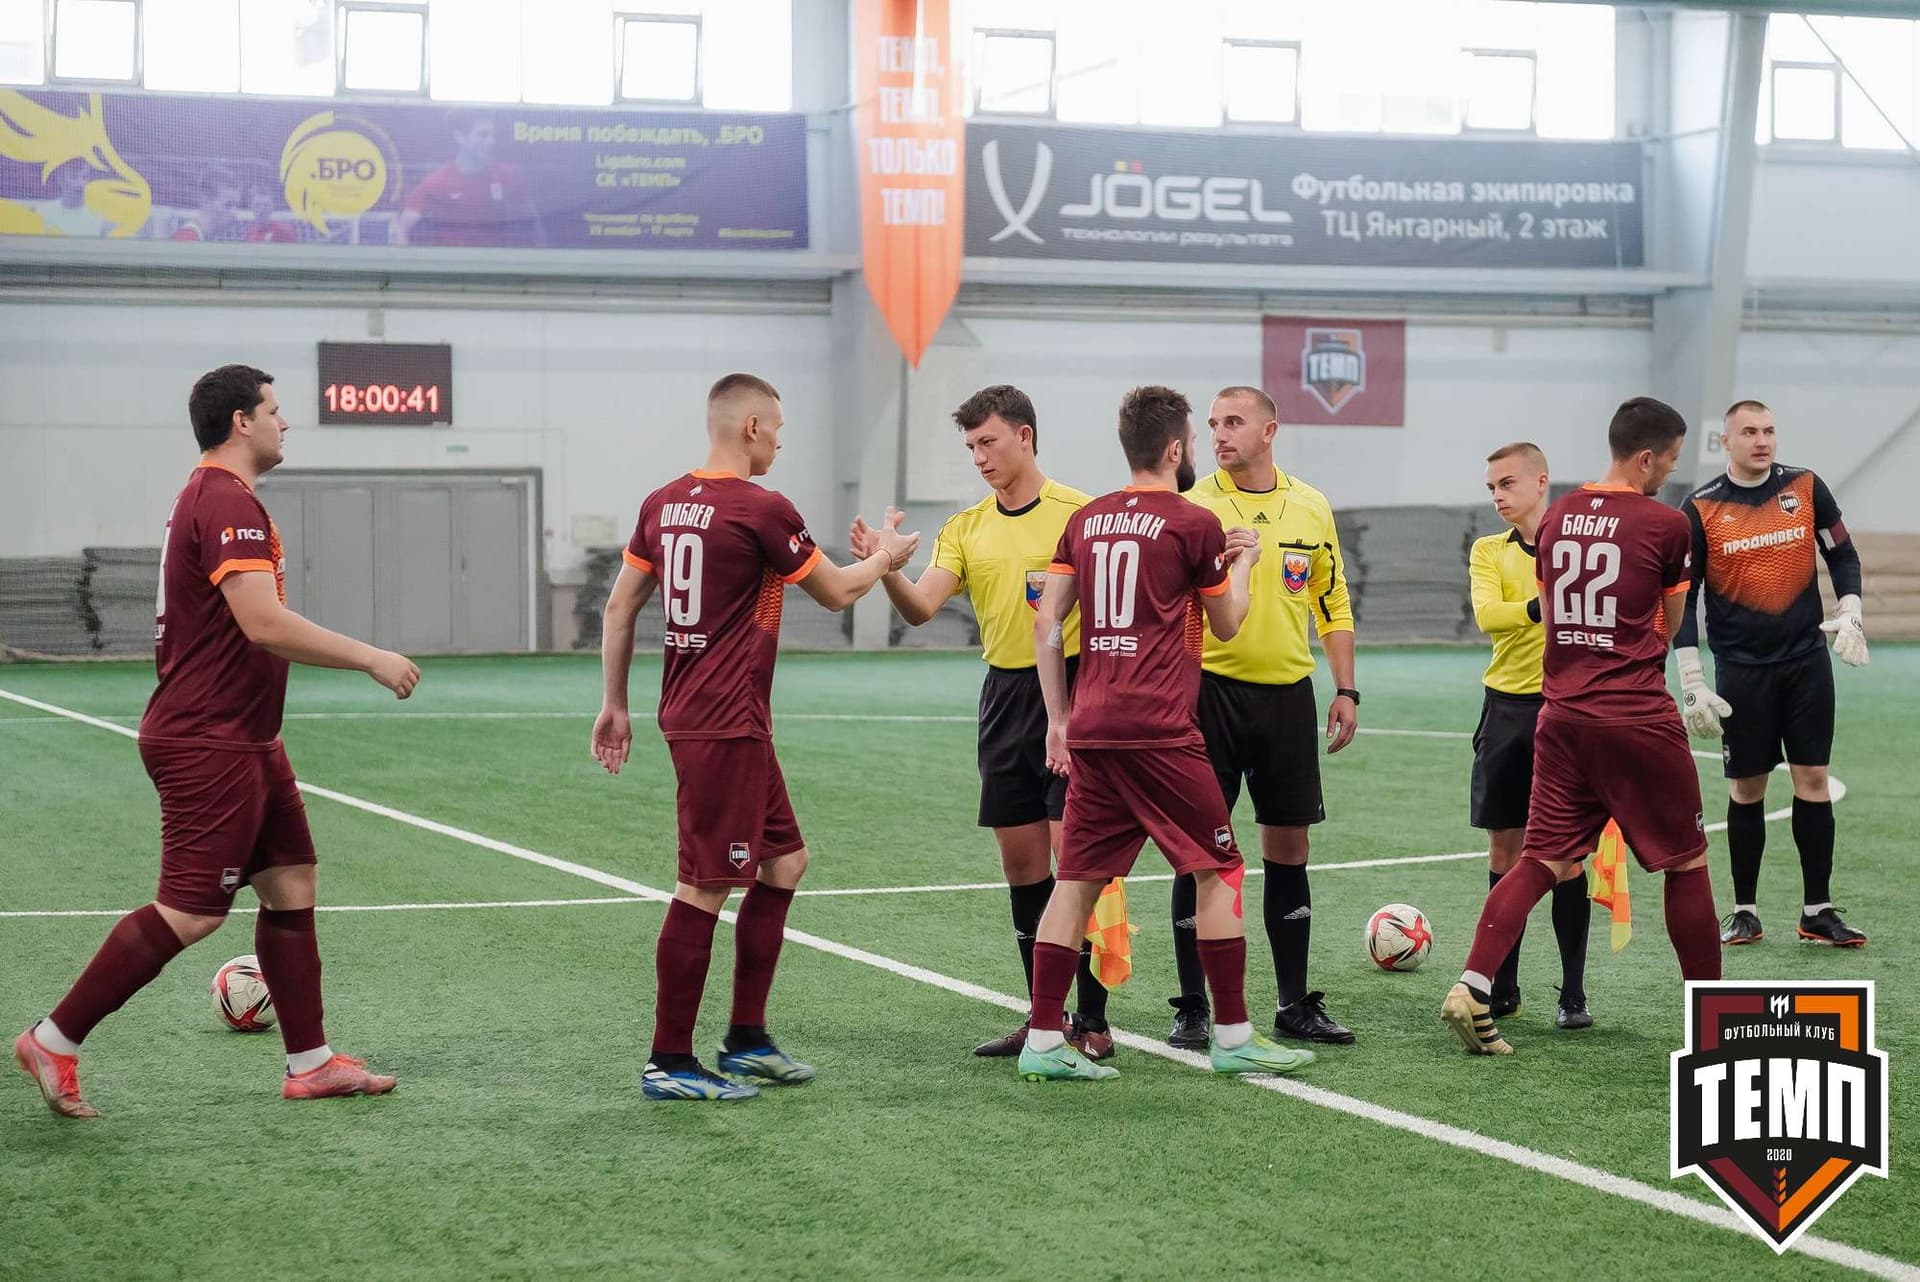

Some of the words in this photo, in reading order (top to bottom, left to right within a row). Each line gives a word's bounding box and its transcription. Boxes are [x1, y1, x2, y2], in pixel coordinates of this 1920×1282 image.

[513, 121, 582, 144] Время
[588, 123, 709, 147] побеждать,
[714, 125, 764, 145] .БРО
[310, 157, 377, 182] .БРО
[868, 137, 957, 176] ТОЛЬКО
[1292, 172, 1465, 204] Футбольная
[1472, 180, 1635, 208] экипировка
[1321, 209, 1362, 241] ТЦ
[1366, 210, 1511, 243] Янтарный,
[1517, 211, 1535, 239] 2
[1541, 216, 1609, 239] этаж
[324, 383, 441, 413] 18:00:41
[660, 502, 716, 530] ШИБАЕВ
[1083, 511, 1167, 541] АПАЛЬКИН
[1561, 514, 1620, 539] БАБИЧ
[236, 528, 266, 541] ПСБ
[1723, 526, 1807, 556] ПРОДИНВЕСТ
[660, 532, 704, 627] 19
[1092, 539, 1140, 629] 10
[1552, 540, 1621, 628] 22
[664, 631, 708, 649] EUS
[1556, 630, 1615, 648] SEUS
